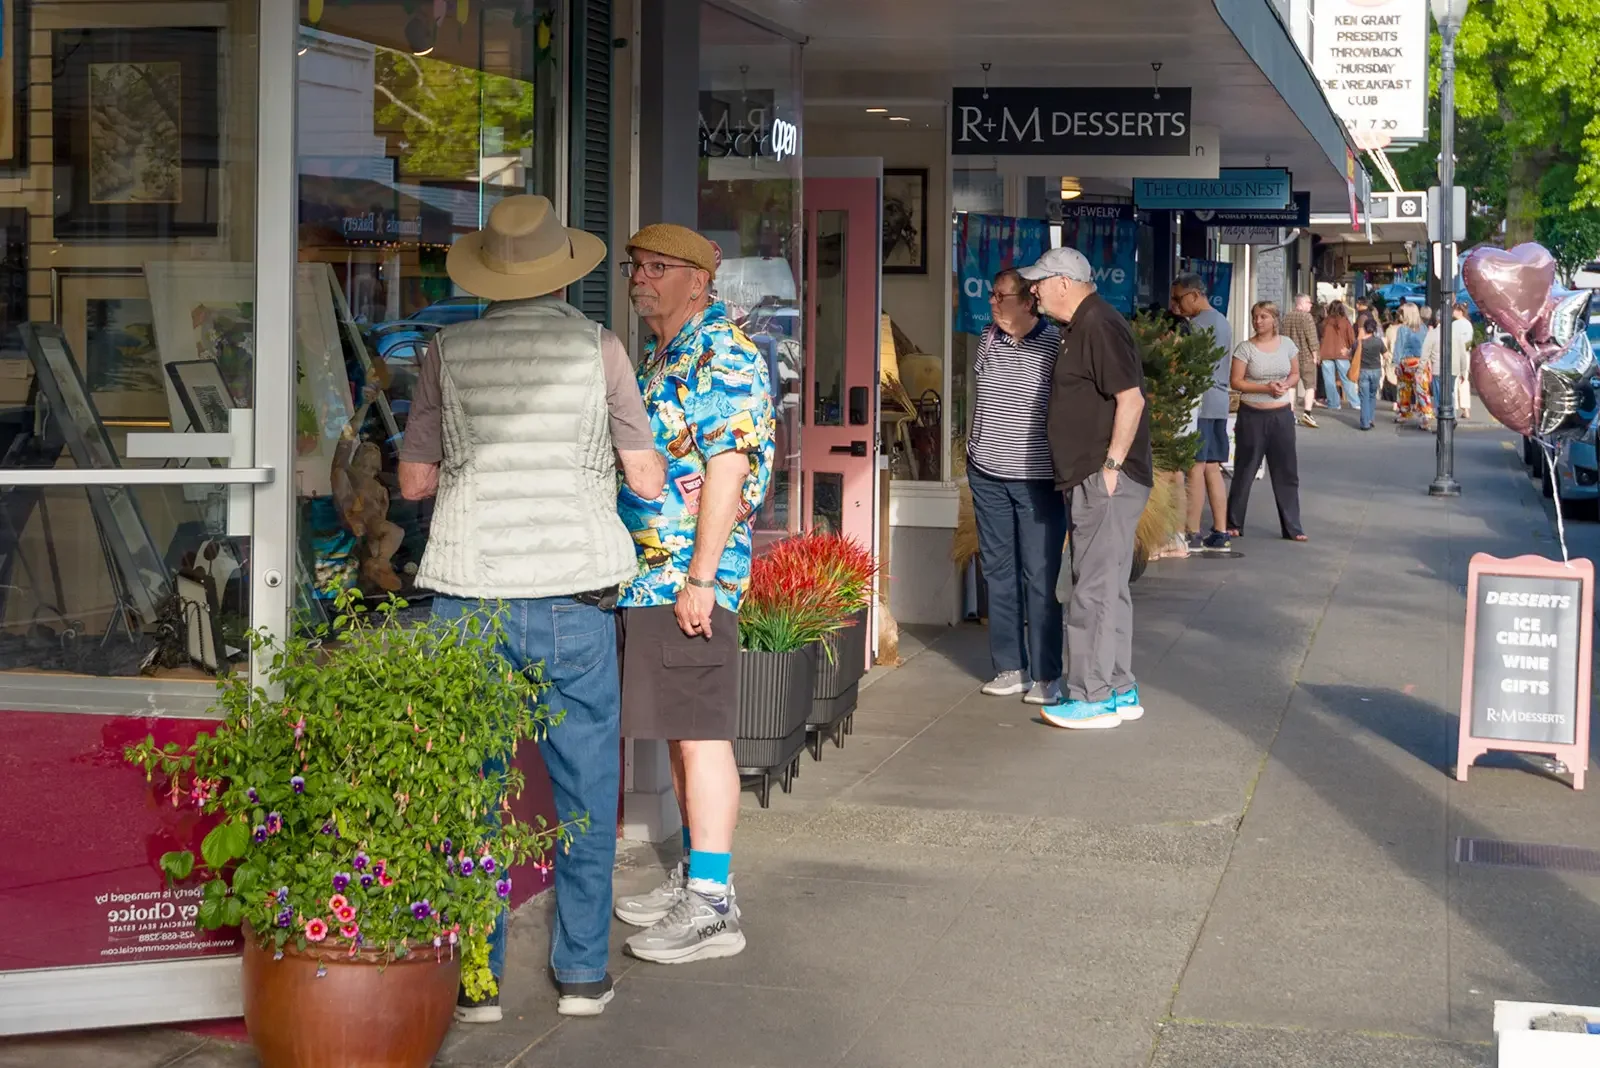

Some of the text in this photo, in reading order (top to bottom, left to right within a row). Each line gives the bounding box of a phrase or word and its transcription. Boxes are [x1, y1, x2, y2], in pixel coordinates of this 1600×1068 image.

[1334, 14, 1402, 26] KEN GRANT
[1336, 31, 1398, 42] PRESENTS
[1330, 47, 1403, 58] THROWBACK
[1322, 79, 1339, 90] HE
[1347, 95, 1378, 106] CLUB
[957, 105, 1186, 143] R+M DESSERTS
[1143, 181, 1284, 198] THE CURIOUS NEST
[1073, 206, 1121, 218] JEWELRY
[1248, 213, 1298, 221] TREASURES
[1485, 591, 1571, 609] DESSERTS
[1513, 617, 1541, 632] ICE
[1496, 631, 1558, 648] CREAM
[1502, 654, 1549, 671] WINE
[1500, 678, 1550, 696] GIFTS
[1518, 710, 1566, 725] DESSERTS
[696, 920, 727, 940] HOKA
